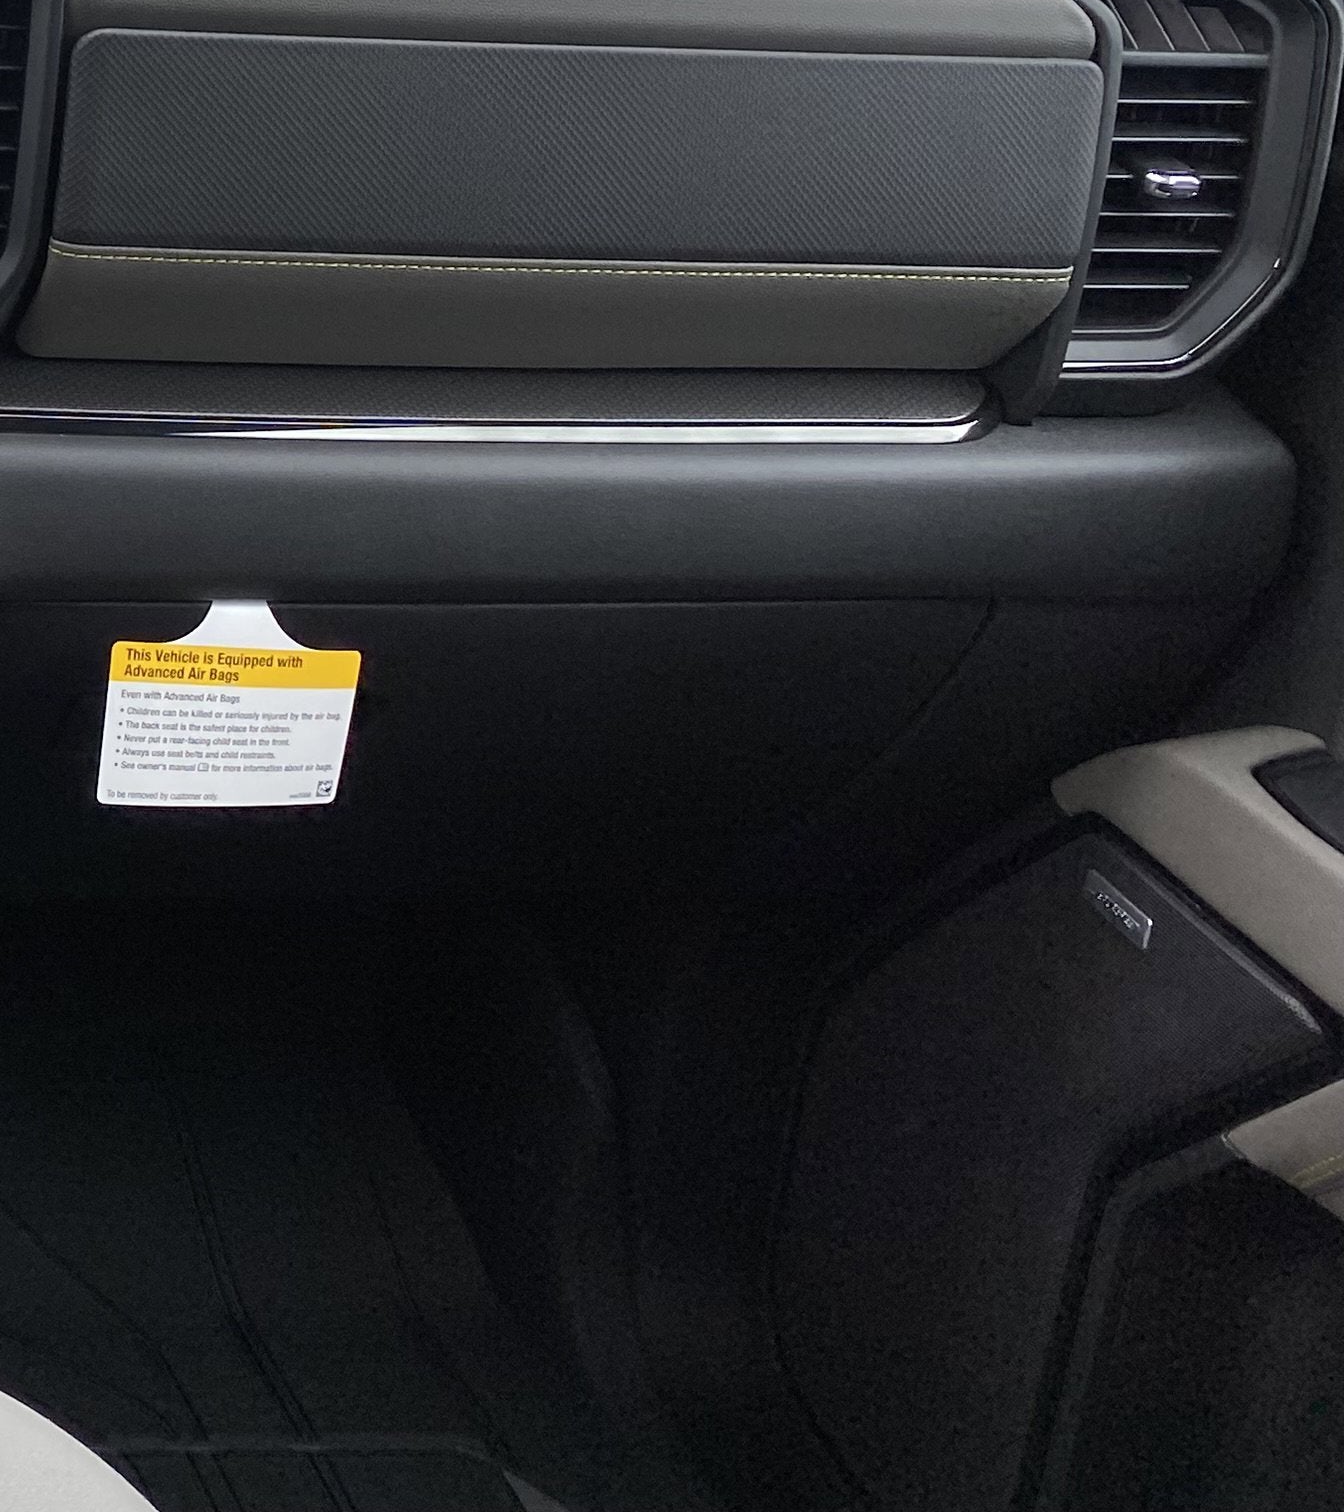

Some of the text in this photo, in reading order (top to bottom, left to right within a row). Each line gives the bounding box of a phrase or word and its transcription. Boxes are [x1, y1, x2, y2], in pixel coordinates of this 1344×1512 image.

[127, 648, 303, 669] This Vehicle is Equipped with
[124, 664, 239, 683] Advanced Air Bags
[121, 689, 240, 704] Even with Advanced Air Bags
[127, 707, 160, 716] Children
[162, 709, 177, 717] can
[179, 708, 189, 717] be
[192, 709, 213, 718] killed
[215, 711, 223, 719] or
[225, 711, 259, 721] seriously
[262, 711, 288, 721] injured
[290, 712, 299, 721] by
[302, 712, 312, 720] the
[126, 720, 140, 729] The
[142, 721, 160, 730] back
[162, 722, 178, 730] seat
[189, 723, 201, 731] the
[203, 724, 225, 732] safest
[227, 725, 247, 733] place
[124, 734, 146, 743] Never
[148, 735, 161, 744] put
[169, 736, 211, 746] rear-facing
[212, 737, 231, 745] child
[232, 738, 248, 746] seat
[259, 738, 270, 746] the
[122, 748, 149, 758] Always
[167, 749, 183, 758] seat
[185, 750, 203, 758] belts
[205, 750, 219, 759] and
[220, 750, 239, 759] child
[121, 761, 136, 769] See
[168, 762, 195, 771] manual
[211, 764, 221, 772] for
[243, 764, 282, 772] information
[107, 789, 115, 798] To
[117, 789, 126, 798] be
[128, 791, 158, 800] removed
[159, 792, 168, 801] by
[170, 792, 202, 801] customer
